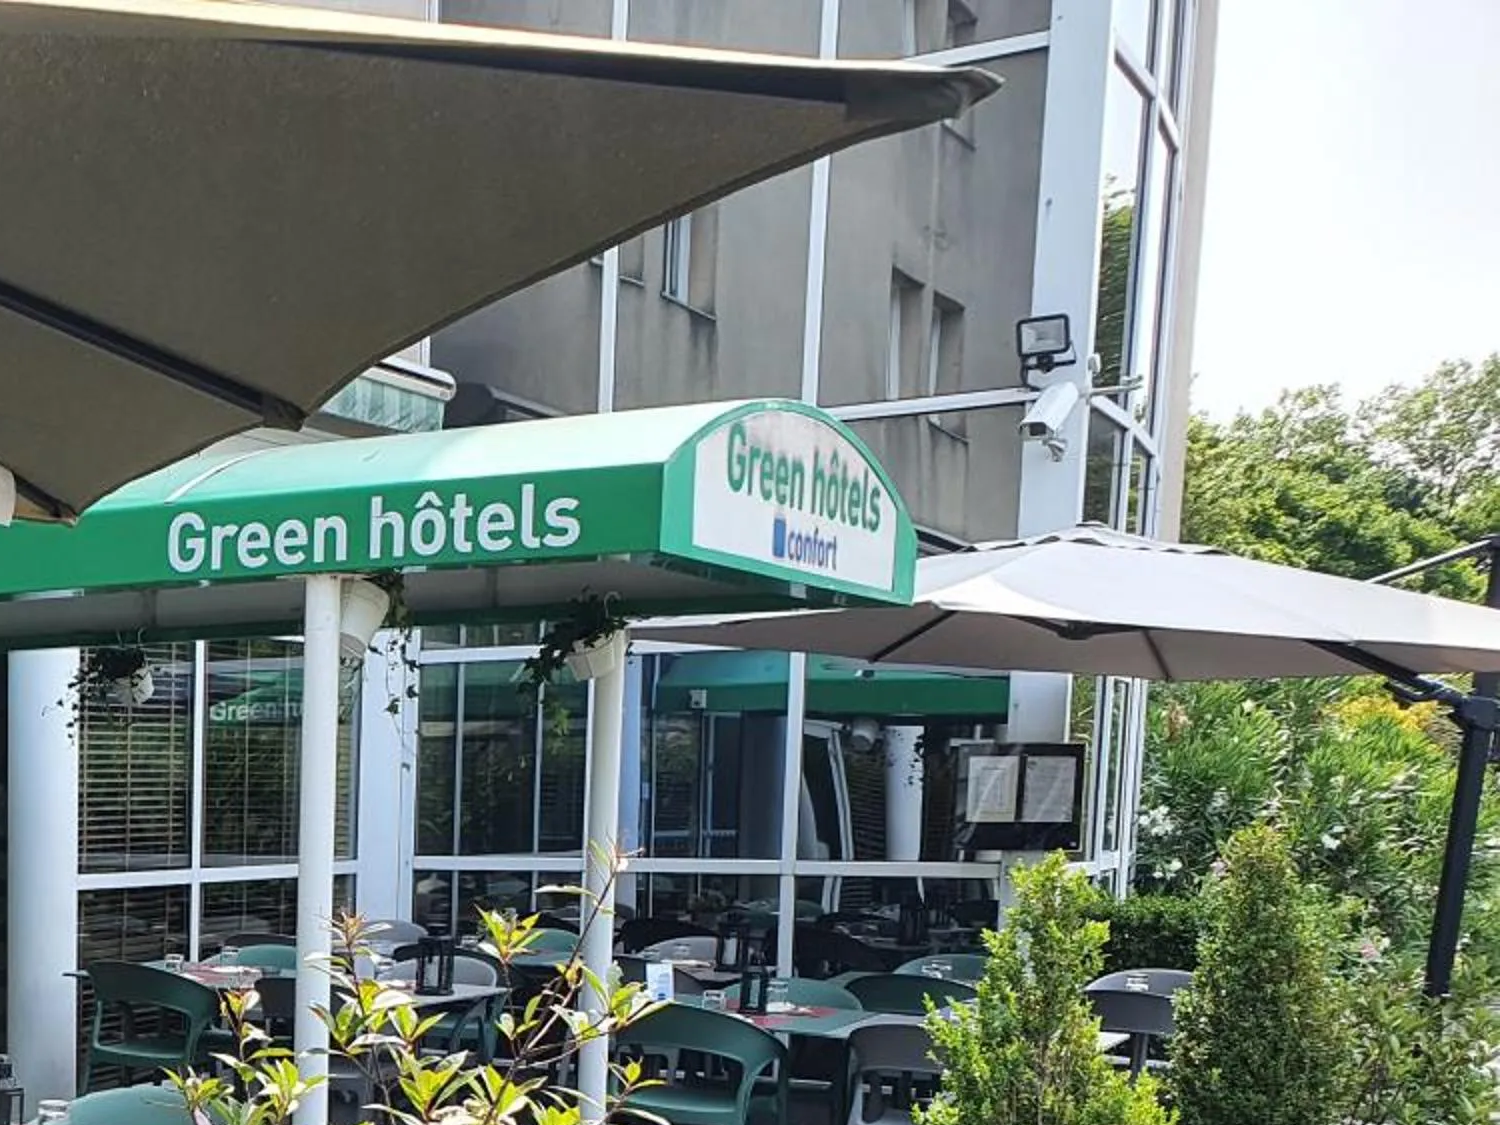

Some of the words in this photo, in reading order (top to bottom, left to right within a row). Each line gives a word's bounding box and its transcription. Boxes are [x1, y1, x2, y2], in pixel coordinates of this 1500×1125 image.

[727, 422, 805, 511] Green
[810, 445, 881, 532] hôtels
[168, 512, 347, 572] Green
[370, 484, 581, 559] hôtels
[787, 527, 837, 570] confort
